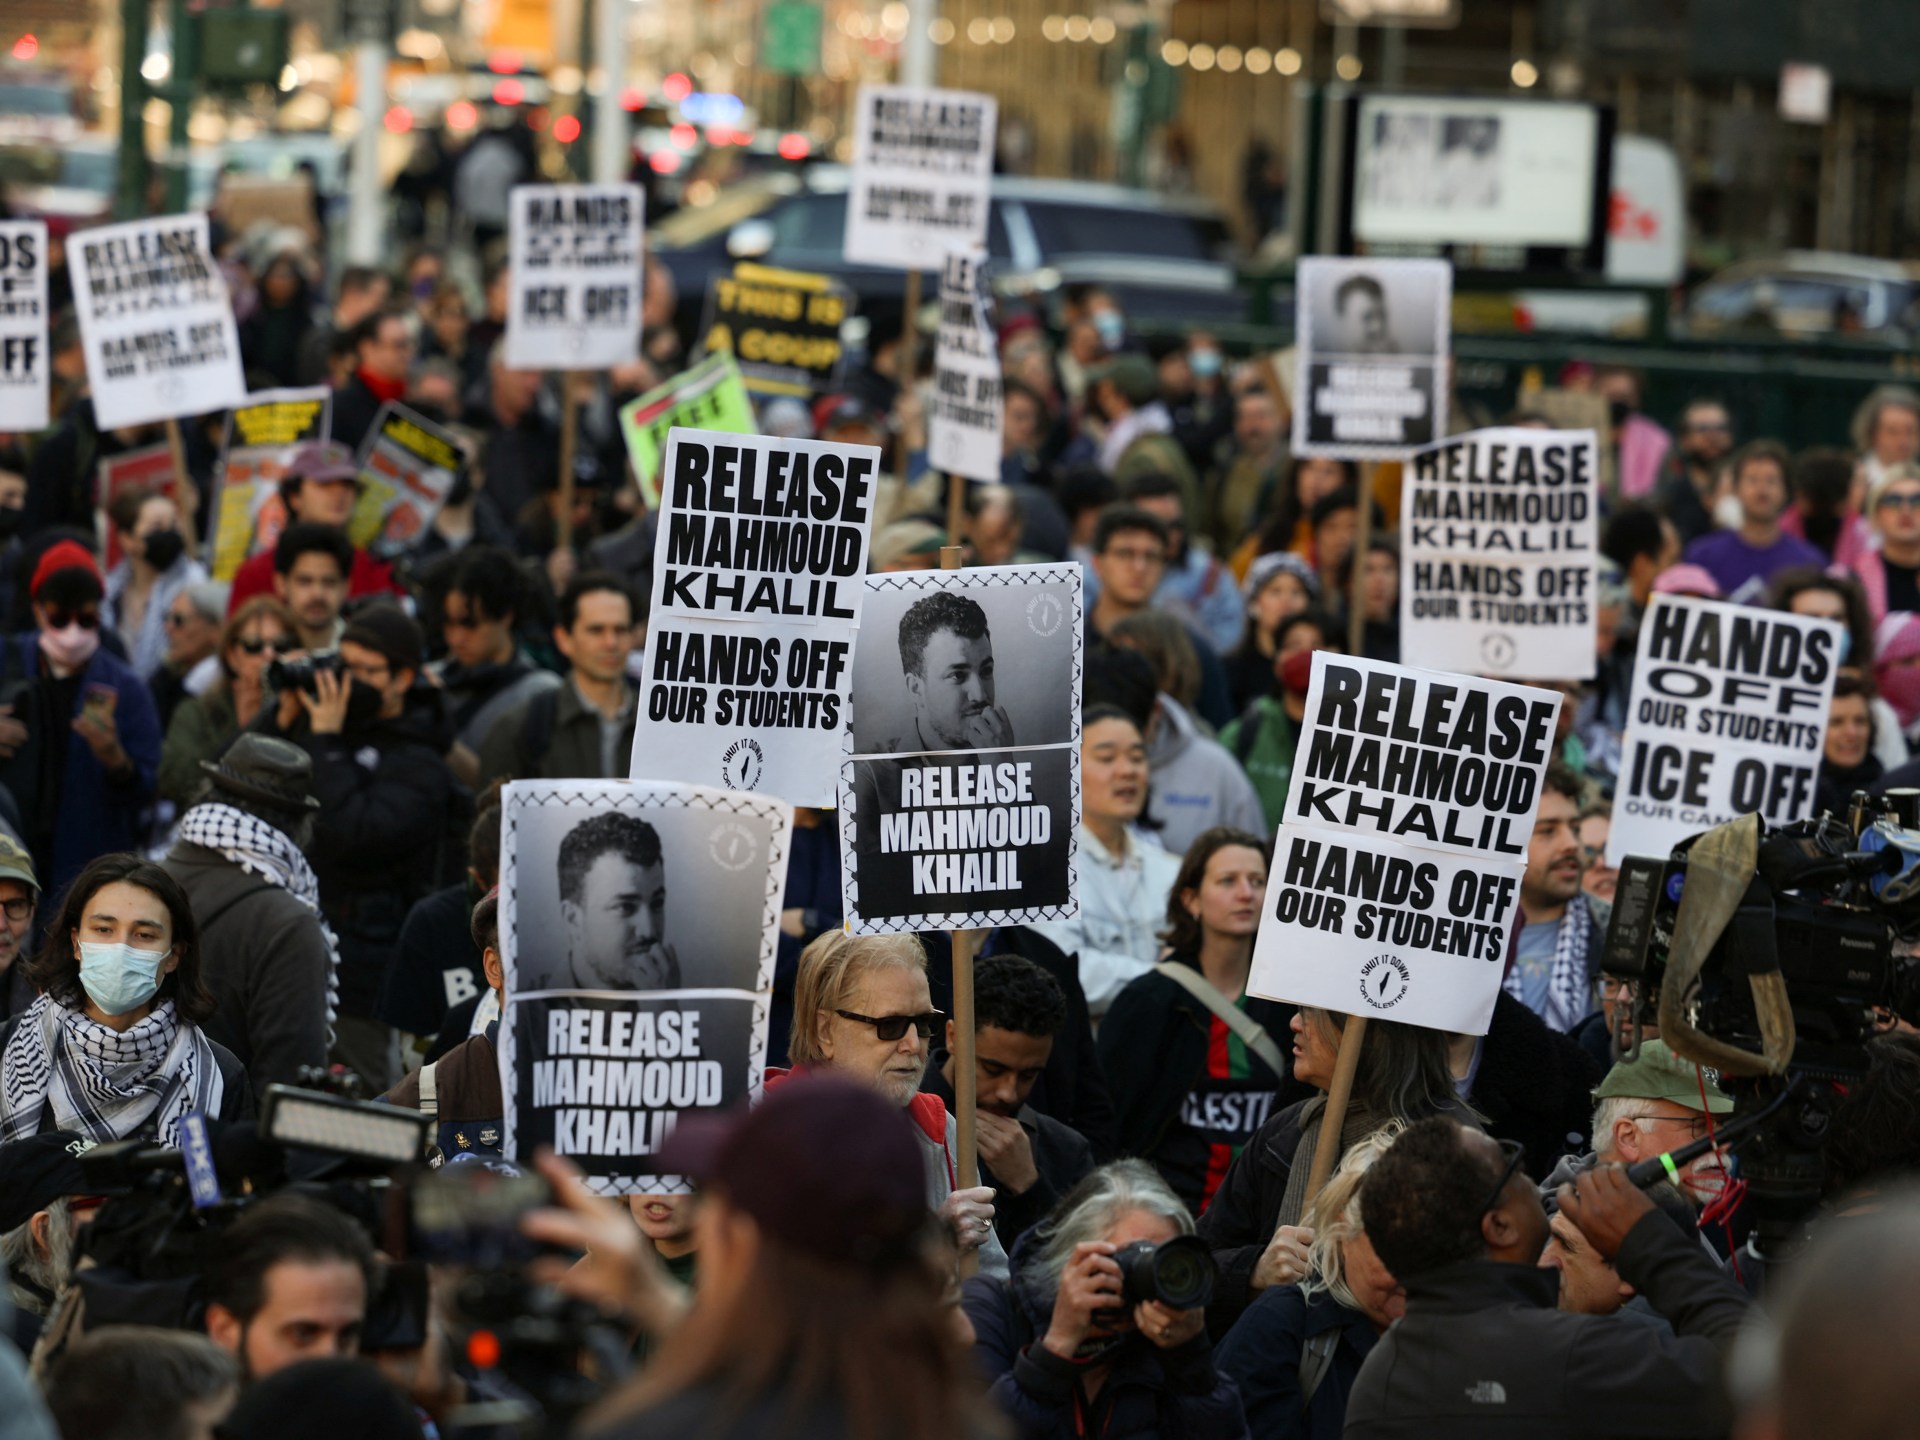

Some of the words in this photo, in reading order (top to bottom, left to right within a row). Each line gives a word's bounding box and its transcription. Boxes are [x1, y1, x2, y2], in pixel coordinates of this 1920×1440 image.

[529, 197, 631, 228] HANDS
[84, 228, 198, 268] RELEASE
[525, 285, 566, 318] ICE
[584, 284, 629, 320] OFF
[715, 278, 803, 321] THIS
[807, 294, 845, 326] IS
[706, 323, 734, 350] A
[739, 328, 842, 369] COUP
[671, 442, 872, 524] RELEASE
[1414, 440, 1589, 487] RELEASE
[1412, 488, 1588, 524] MAHMOUD
[666, 512, 862, 577] MAHMOUD
[1412, 526, 1588, 552] KHALIL
[661, 569, 855, 619] KHALIL
[1413, 561, 1524, 598] HANDS
[1537, 567, 1589, 599] OFF
[1413, 597, 1459, 620] OUR
[1470, 601, 1588, 626] STUDENTS
[653, 630, 780, 689] HANDS
[786, 638, 849, 690] OFF
[1648, 604, 1833, 685] HANDS
[648, 685, 708, 725] OUR
[715, 688, 841, 730] STUDENTS
[1316, 664, 1555, 765] RELEASE
[1647, 667, 1822, 715] OFF
[1638, 698, 1689, 731] OUR
[1696, 708, 1820, 751] STUDENTS
[722, 741, 741, 763] SHUT
[741, 738, 748, 749] IT
[748, 739, 763, 763] DOWN!
[1305, 729, 1537, 815] MAHMOUD
[722, 767, 733, 788] FOR
[901, 762, 1033, 808] RELEASE
[1628, 740, 1715, 808] ICE
[1729, 758, 1814, 822] OFF
[880, 805, 1051, 854] MAHMOUD
[1297, 782, 1524, 855] KHALIL
[1625, 801, 1674, 824] OUR
[912, 849, 1023, 895] KHALIL
[1283, 837, 1439, 910] HANDS
[1447, 869, 1516, 923] OFF
[1275, 888, 1345, 935] OUR
[1354, 904, 1504, 963] STUDENTS
[1840, 935, 1876, 951] Panasonic
[1361, 956, 1380, 977] SHUT
[1381, 954, 1389, 964] IT
[1389, 955, 1410, 981] DOWN!
[1360, 978, 1369, 1000] FOR
[1366, 984, 1408, 1009] PALESTINE
[548, 1008, 701, 1058] RELEASE
[532, 1059, 723, 1108] MAHMOUD
